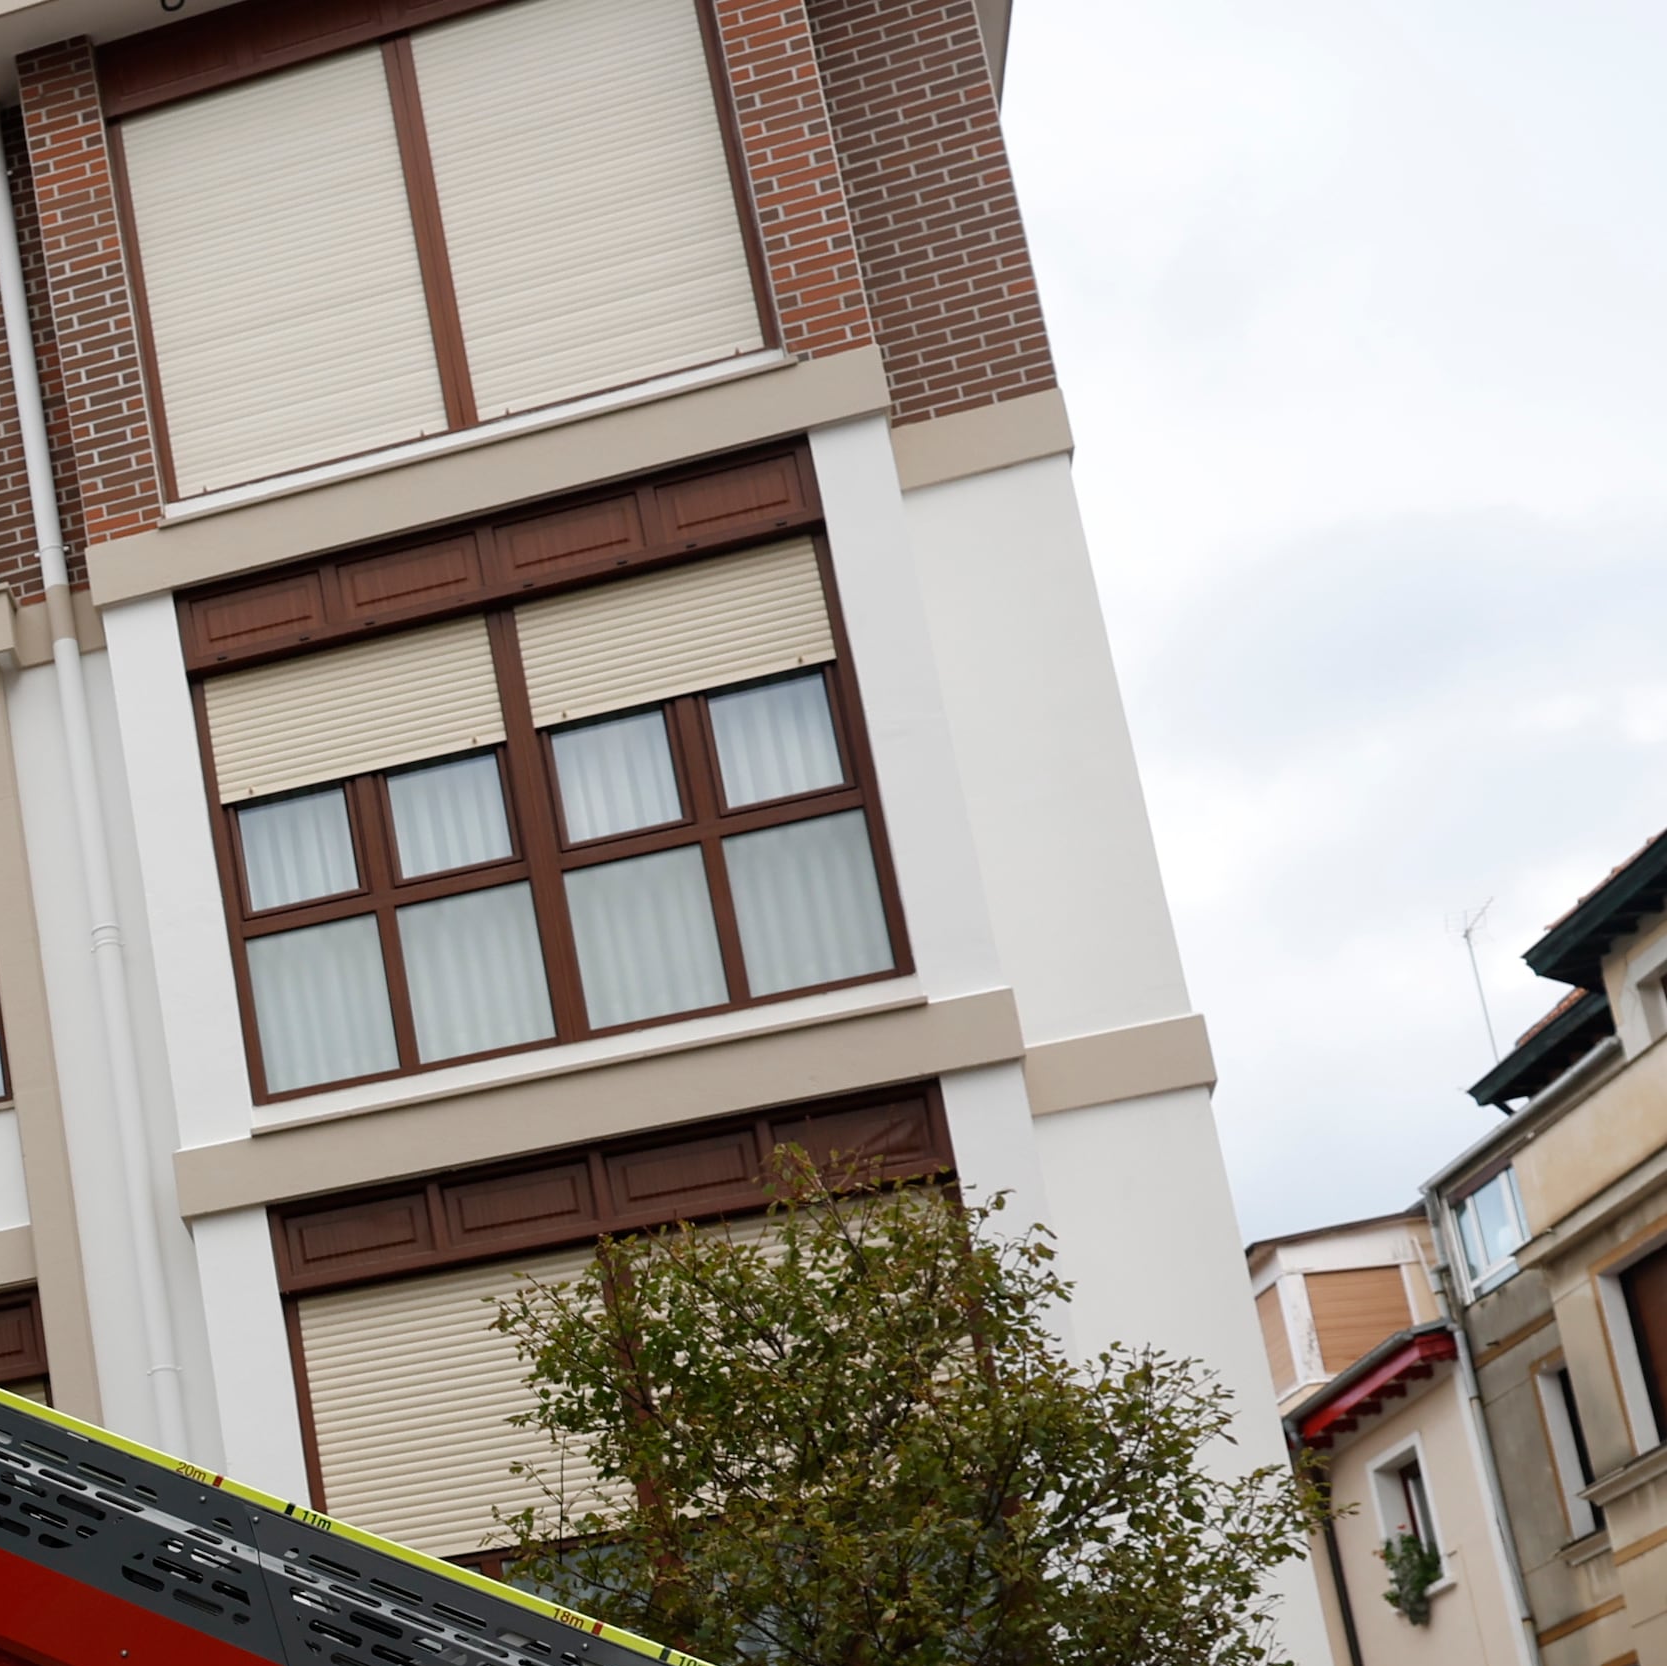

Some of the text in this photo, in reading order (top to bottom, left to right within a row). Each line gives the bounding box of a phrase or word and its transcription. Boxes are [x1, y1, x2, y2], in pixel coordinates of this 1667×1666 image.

[175, 1460, 207, 1483] 20m
[302, 1510, 332, 1532] 11m
[552, 1608, 585, 1630] 18m
